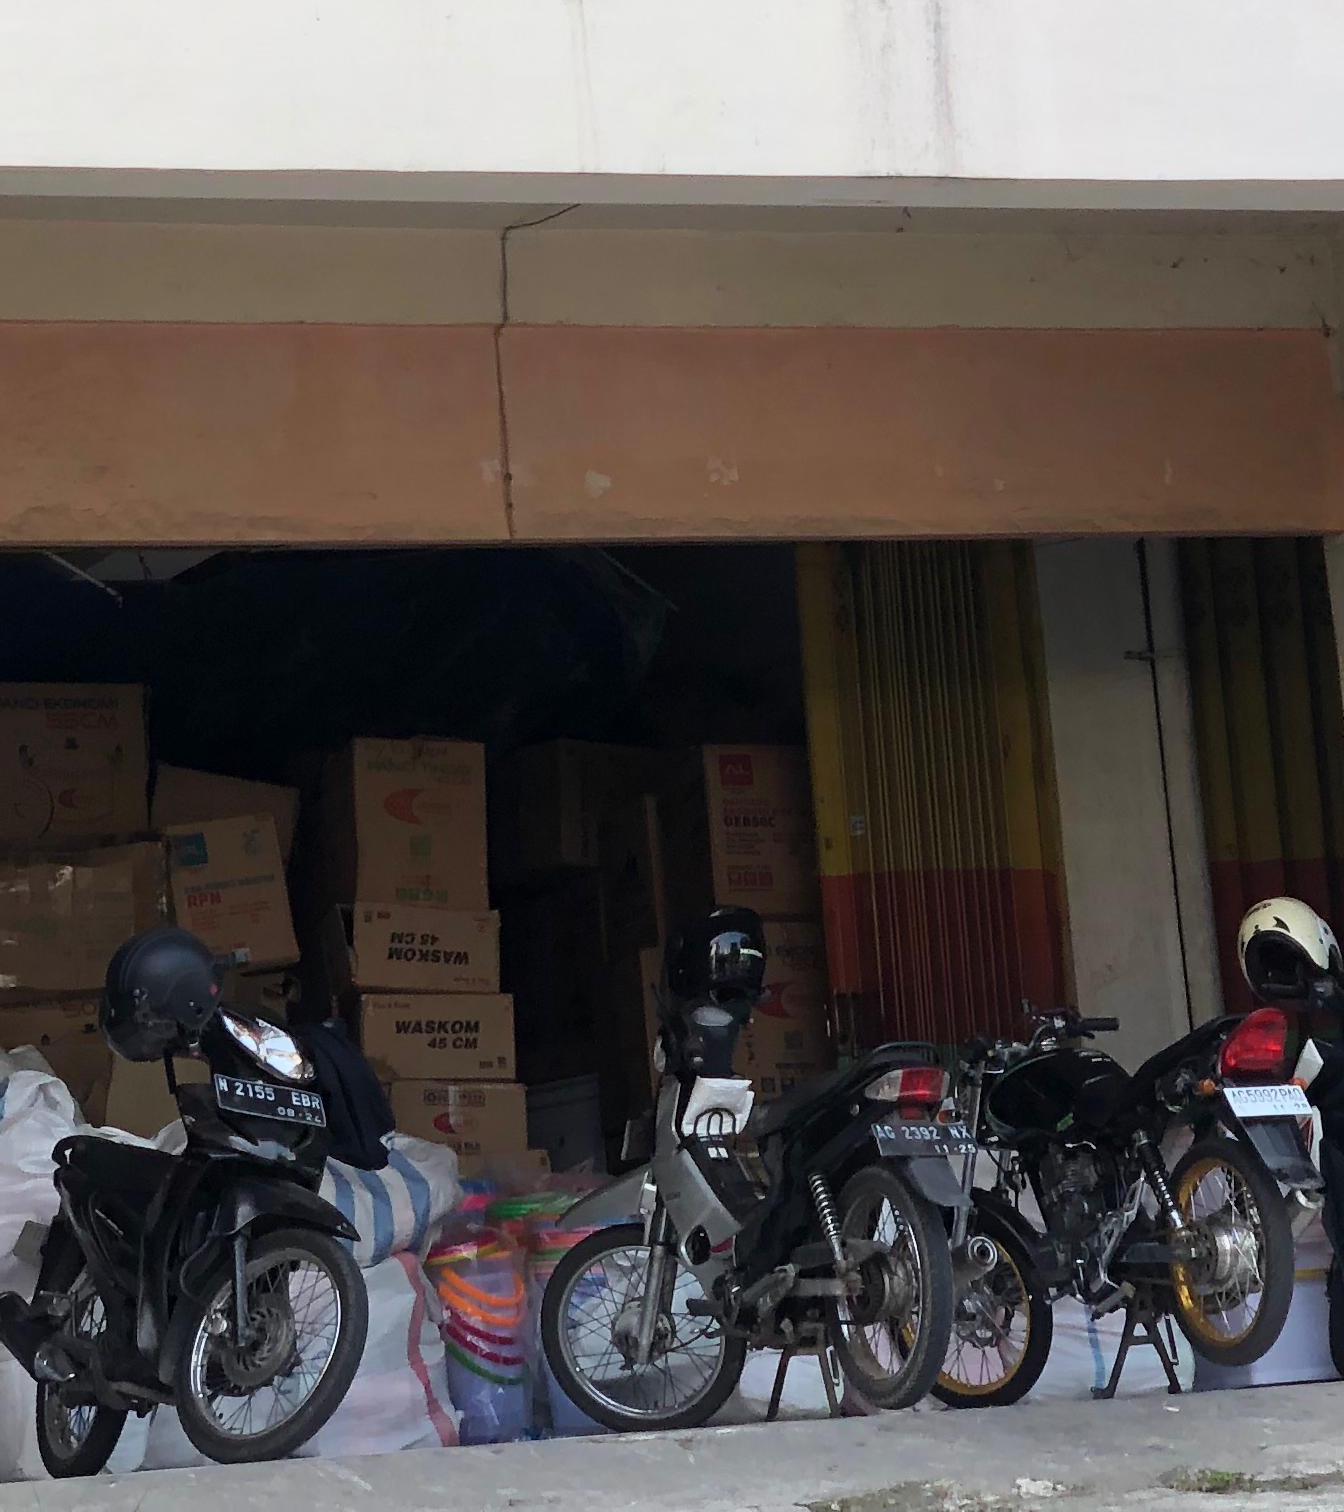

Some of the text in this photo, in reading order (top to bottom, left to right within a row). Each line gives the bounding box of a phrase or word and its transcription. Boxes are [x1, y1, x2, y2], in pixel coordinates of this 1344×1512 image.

[390, 932, 416, 945] CM
[387, 947, 470, 966] WASKOM
[394, 1020, 481, 1035] WASKOM
[426, 1037, 479, 1050] 45 CM
[234, 1081, 276, 1102] 2155
[290, 1091, 321, 1110] EBR
[901, 1125, 942, 1140] 2392
